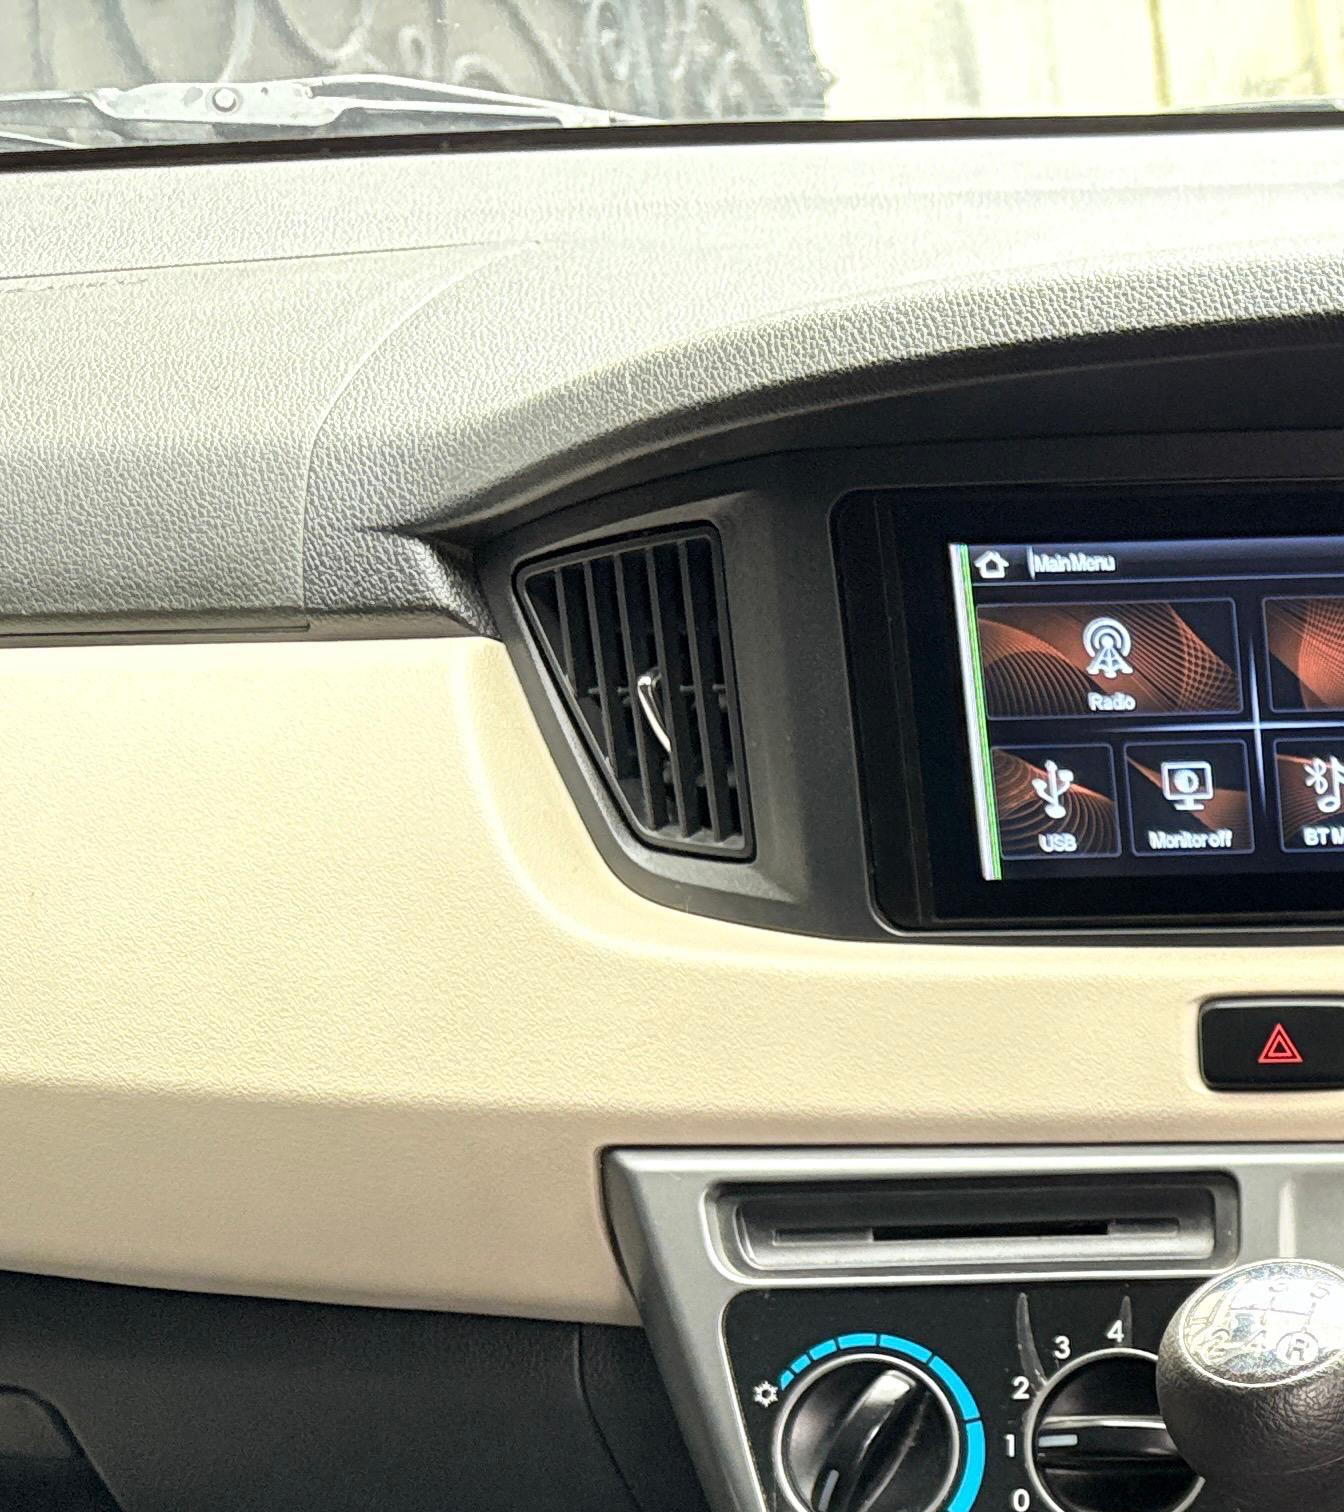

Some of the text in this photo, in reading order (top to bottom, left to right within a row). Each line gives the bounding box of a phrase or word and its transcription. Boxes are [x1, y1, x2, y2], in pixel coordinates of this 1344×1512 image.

[1088, 691, 1136, 712] Radio
[1038, 834, 1078, 853] USB
[1148, 828, 1233, 849] Monitor off
[1303, 826, 1330, 846] BT
[1107, 1319, 1123, 1341] 4
[1053, 1336, 1072, 1361] 3
[1012, 1376, 1030, 1400] 2
[1005, 1433, 1016, 1458] 1
[1012, 1488, 1030, 1512] 0
